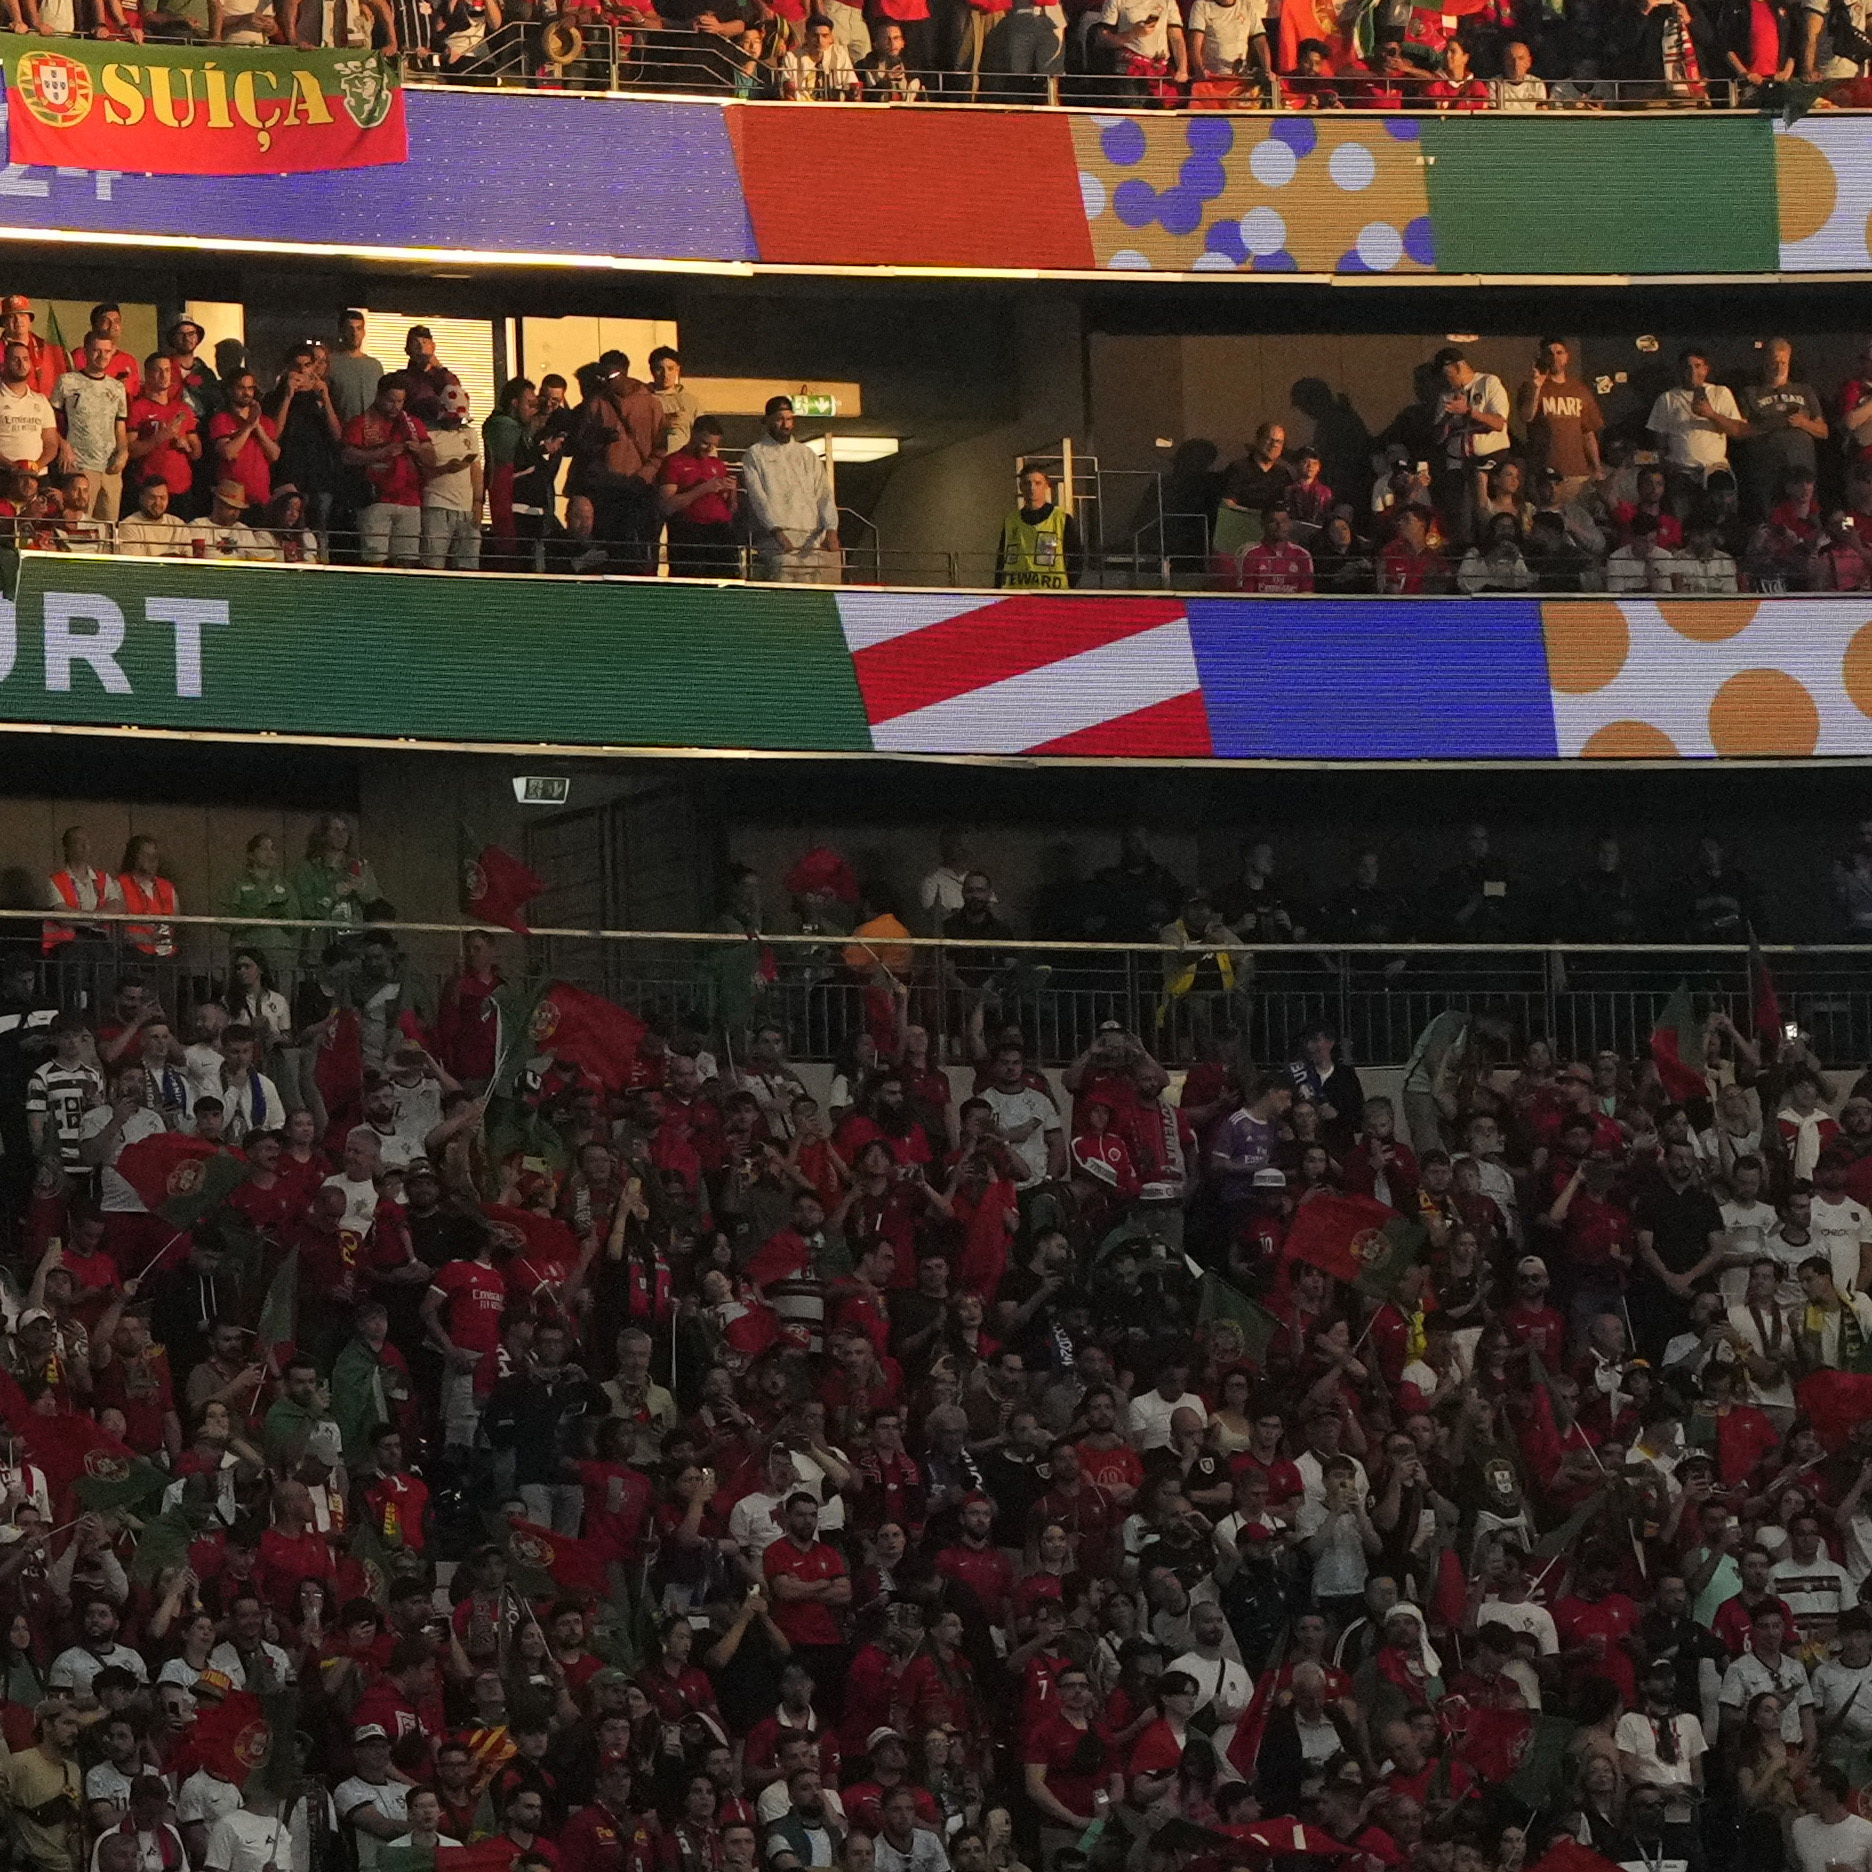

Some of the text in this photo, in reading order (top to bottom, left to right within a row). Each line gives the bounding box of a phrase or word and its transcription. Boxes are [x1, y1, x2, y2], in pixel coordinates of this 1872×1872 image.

[102, 61, 334, 152] SUÍÇA
[73, 393, 81, 409] 7
[4, 415, 42, 426] Emirates
[151, 420, 160, 433] 7
[1742, 1633, 1752, 1652] 6
[1037, 1680, 1048, 1701] 7
